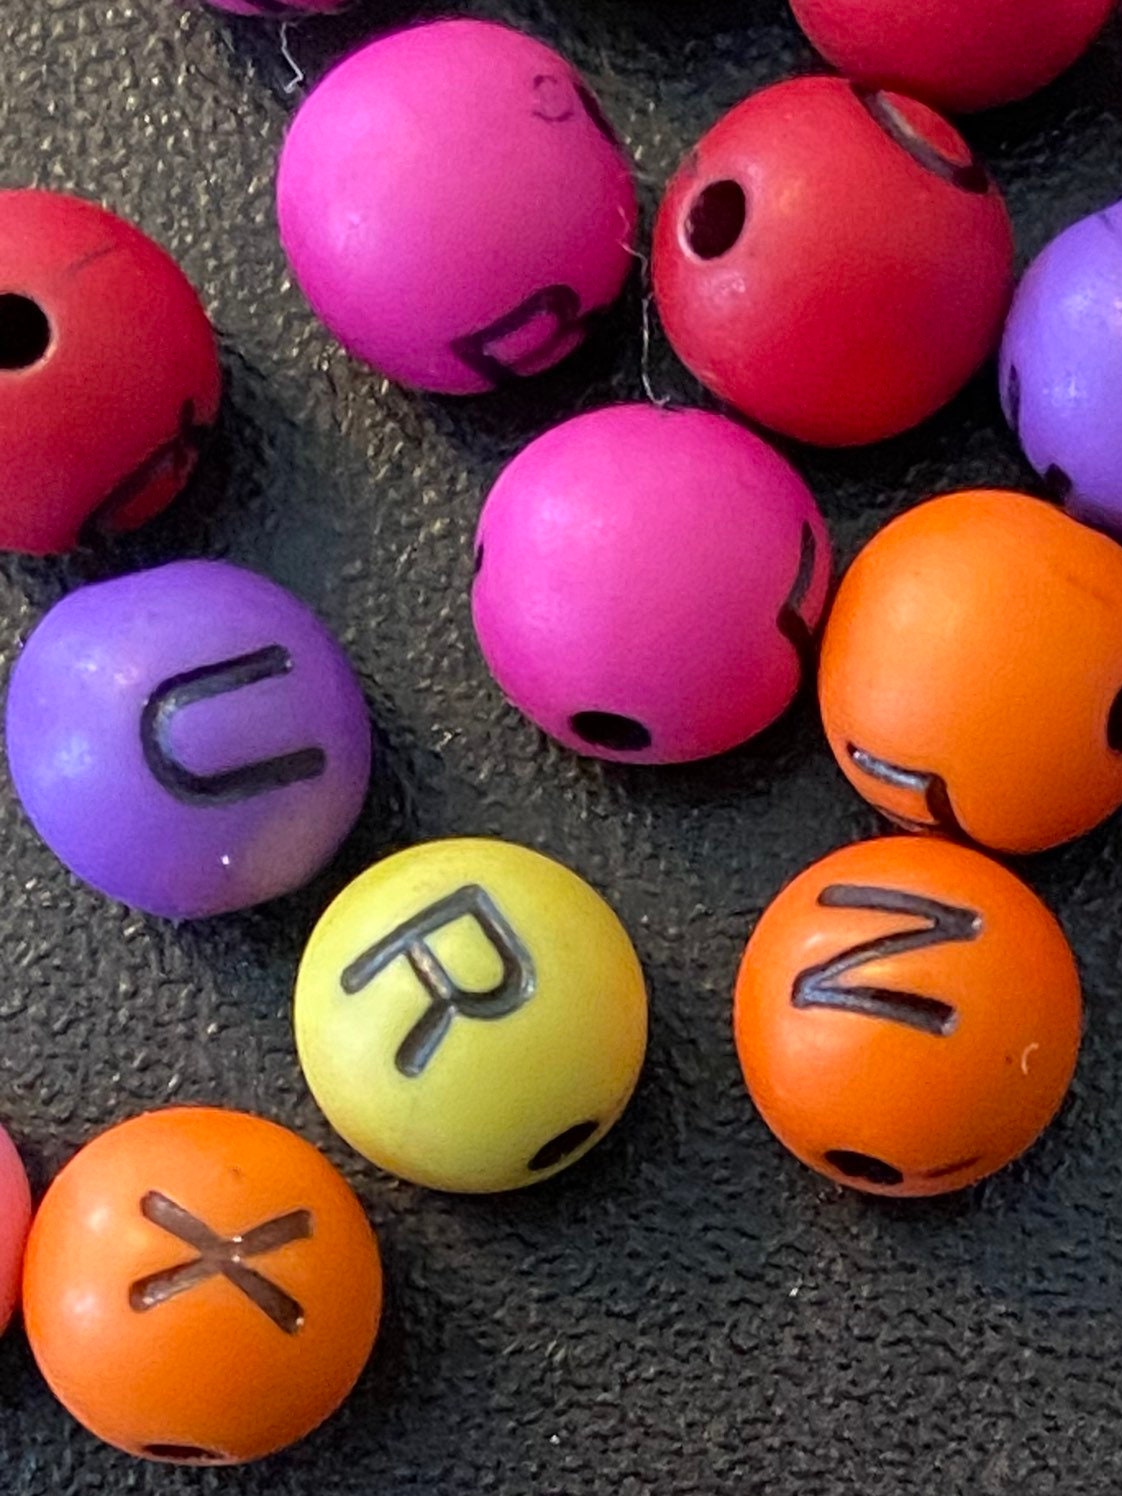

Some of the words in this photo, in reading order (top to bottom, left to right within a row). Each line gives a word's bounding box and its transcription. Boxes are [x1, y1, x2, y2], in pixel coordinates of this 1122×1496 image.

[140, 644, 326, 805] U
[341, 884, 535, 1077] R
[129, 1190, 314, 1335] X
